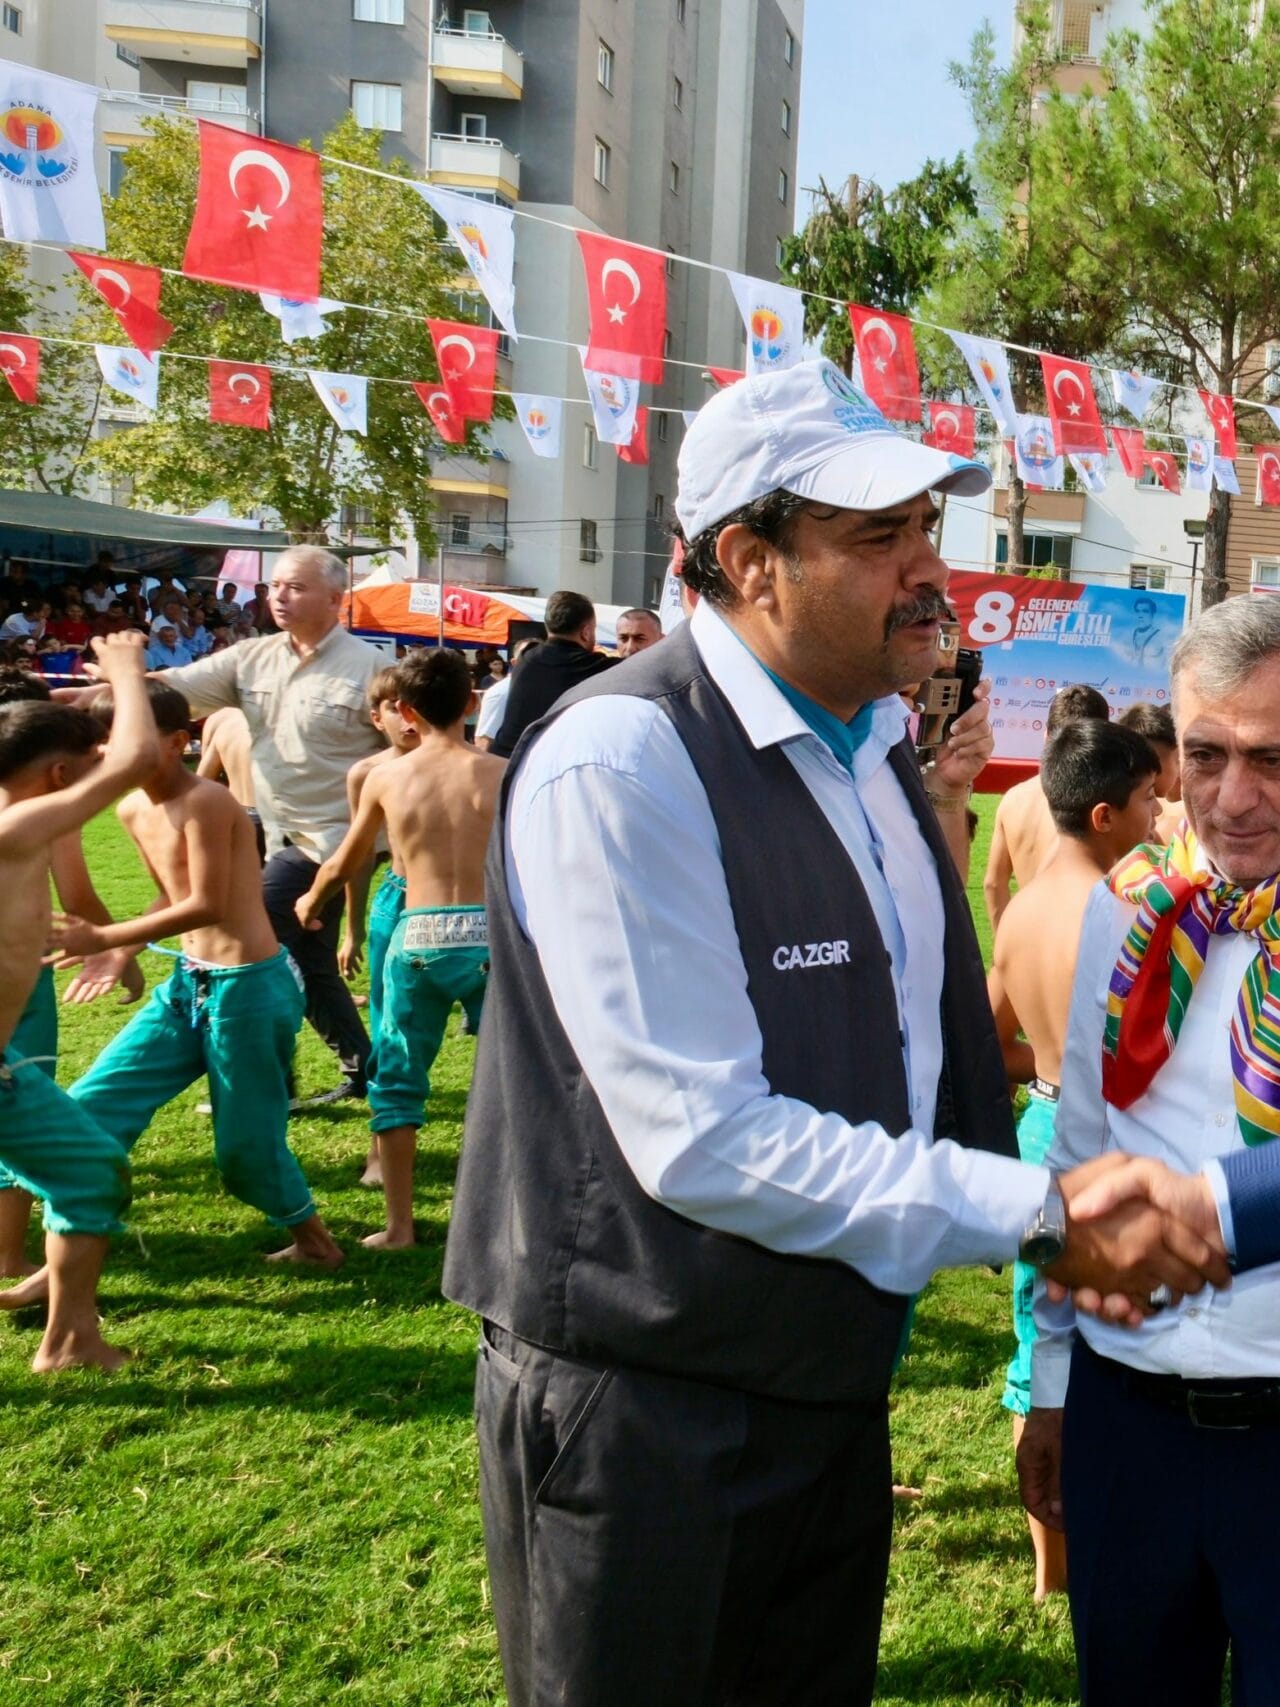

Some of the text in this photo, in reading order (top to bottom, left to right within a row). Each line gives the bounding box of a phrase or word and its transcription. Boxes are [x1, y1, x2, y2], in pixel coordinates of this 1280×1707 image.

[9, 100, 52, 116] ADANA
[1028, 598, 1090, 612] GELENEKSEL
[1015, 606, 1112, 635] İSMET ATLI
[772, 940, 851, 971] CAZGIR
